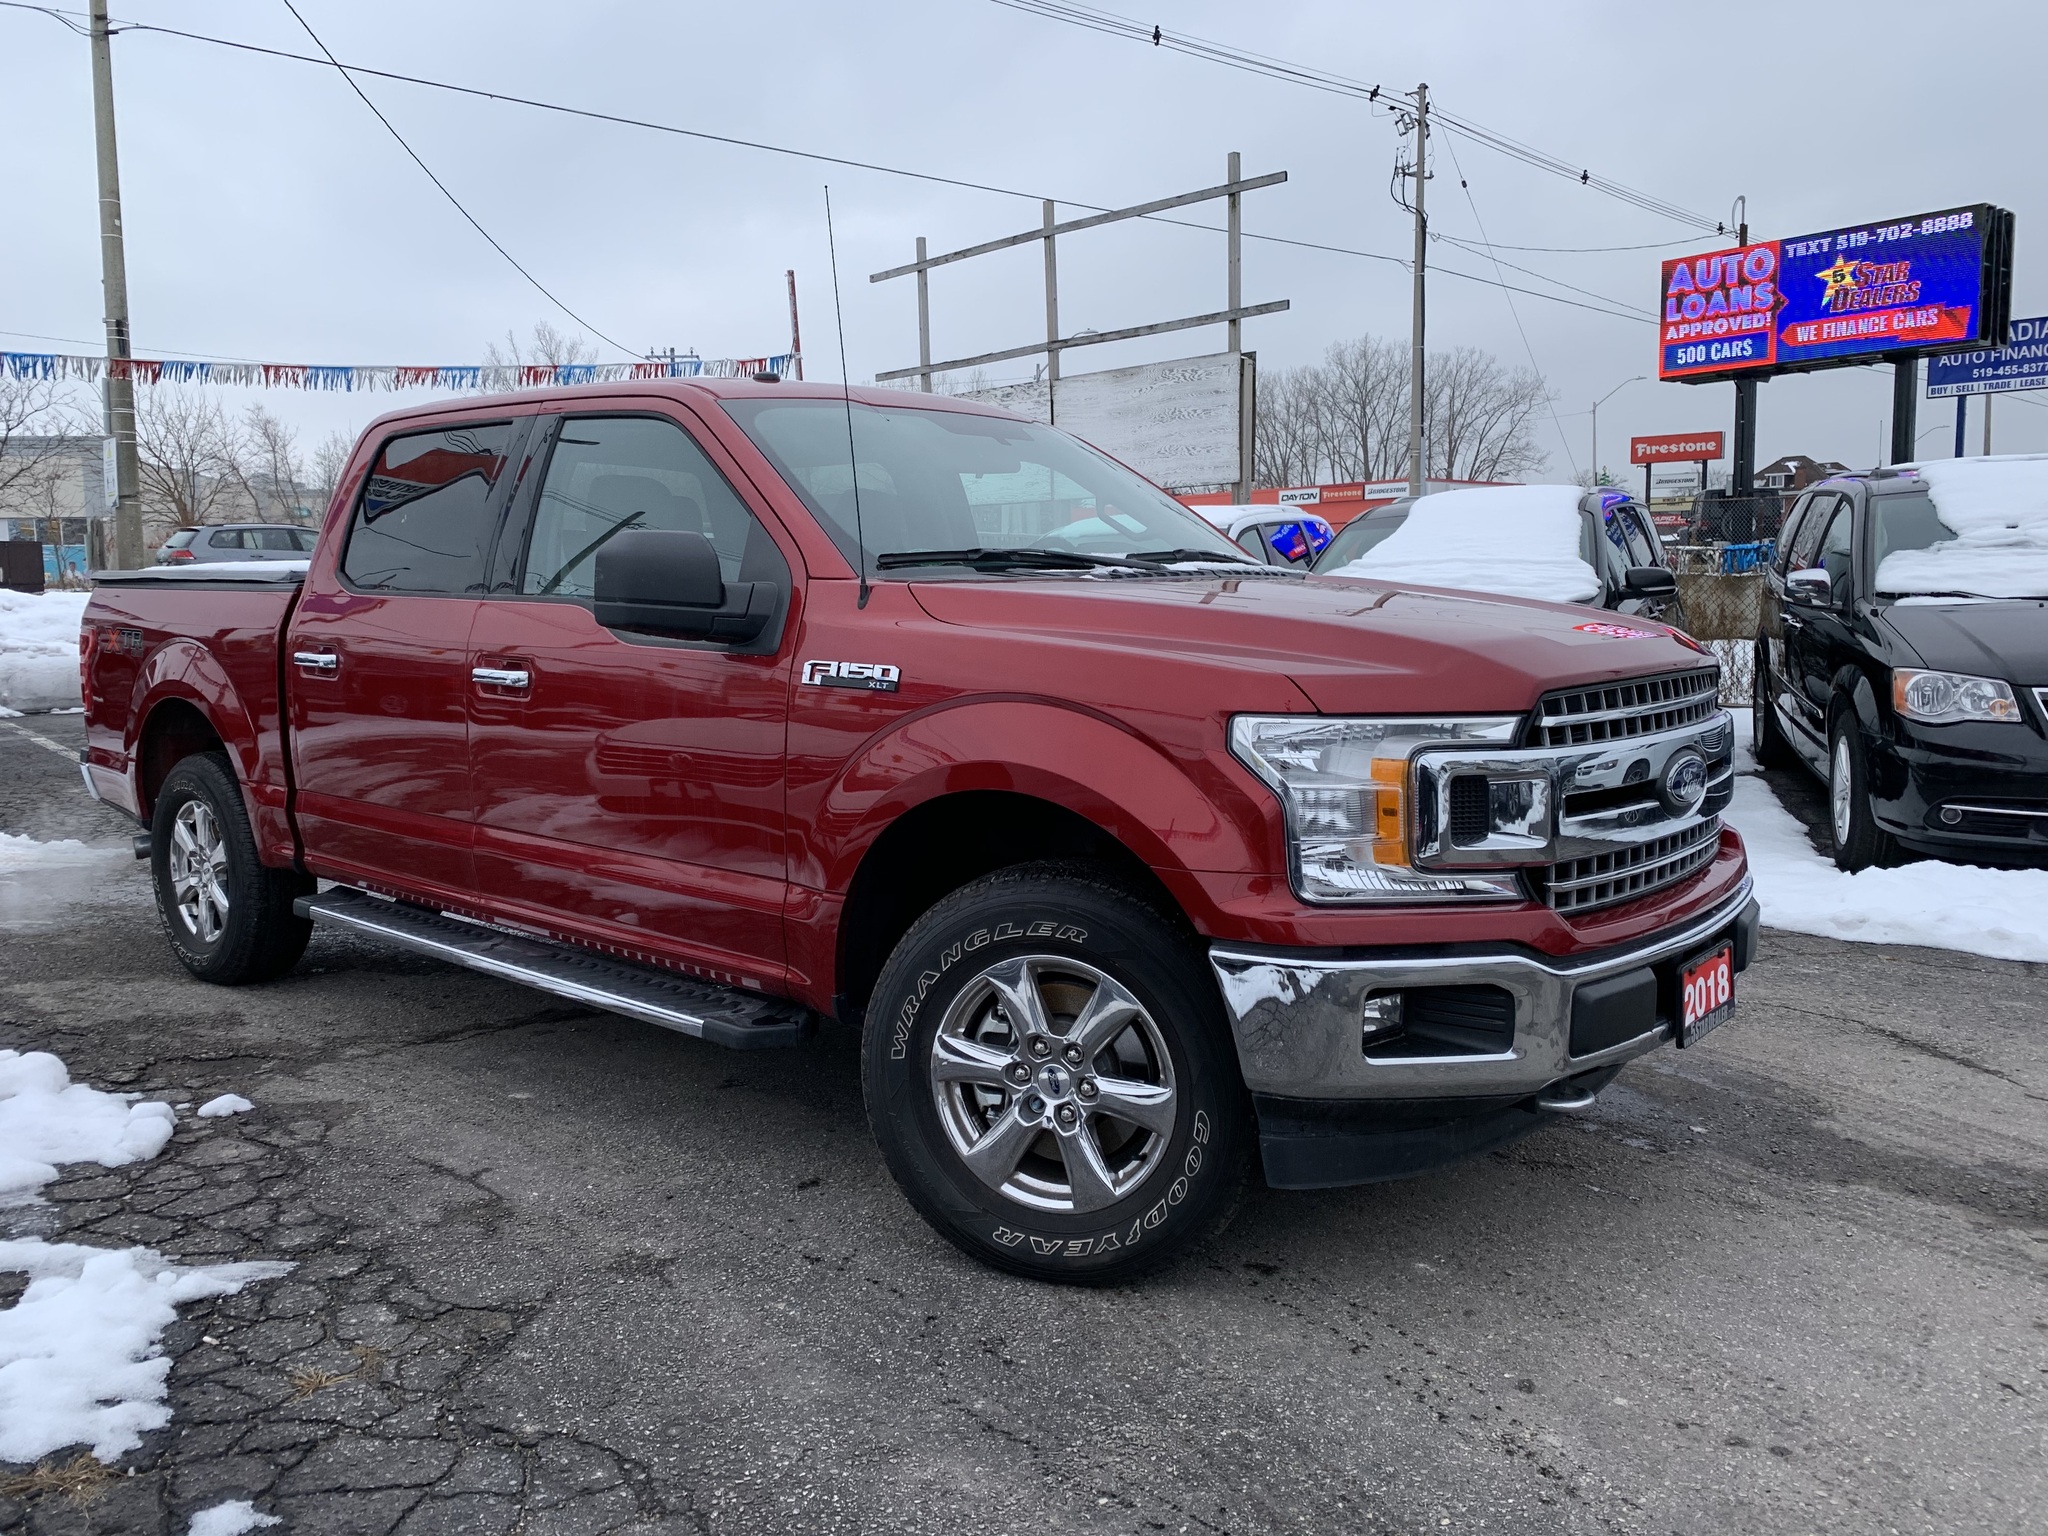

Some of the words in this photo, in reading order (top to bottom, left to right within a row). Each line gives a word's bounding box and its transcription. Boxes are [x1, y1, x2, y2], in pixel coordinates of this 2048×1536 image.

[1785, 238, 1832, 258] TEXT
[1837, 212, 1974, 250] 519-702-8888
[1667, 247, 1775, 293] AUTO
[1832, 268, 1847, 284] 5
[1854, 260, 1911, 288] STAR
[1666, 281, 1775, 322] LOANS
[1829, 280, 1921, 313] DEALERS
[1665, 311, 1772, 340] APPROVED!
[1796, 325, 1818, 342] WE
[1822, 315, 1889, 339] FINANCE
[1893, 307, 1939, 331] CARS
[1677, 345, 1706, 364] 500
[1711, 338, 1753, 360] CARS
[1938, 350, 1985, 367] AUTO
[1930, 386, 1948, 396] BUY
[1956, 384, 1975, 393] SELL
[1983, 380, 2012, 391] TRADE
[2020, 377, 2047, 388] LEASE
[1635, 441, 1717, 457] Firestone
[1281, 492, 1318, 502] DAYTON
[1322, 489, 1363, 500] Firestone
[104, 626, 143, 655] XTR
[868, 681, 889, 689] XLT
[890, 920, 1088, 1060] WRANGLER
[1684, 963, 1730, 1027] 2018
[992, 1110, 1211, 1257] GOODYEAR
